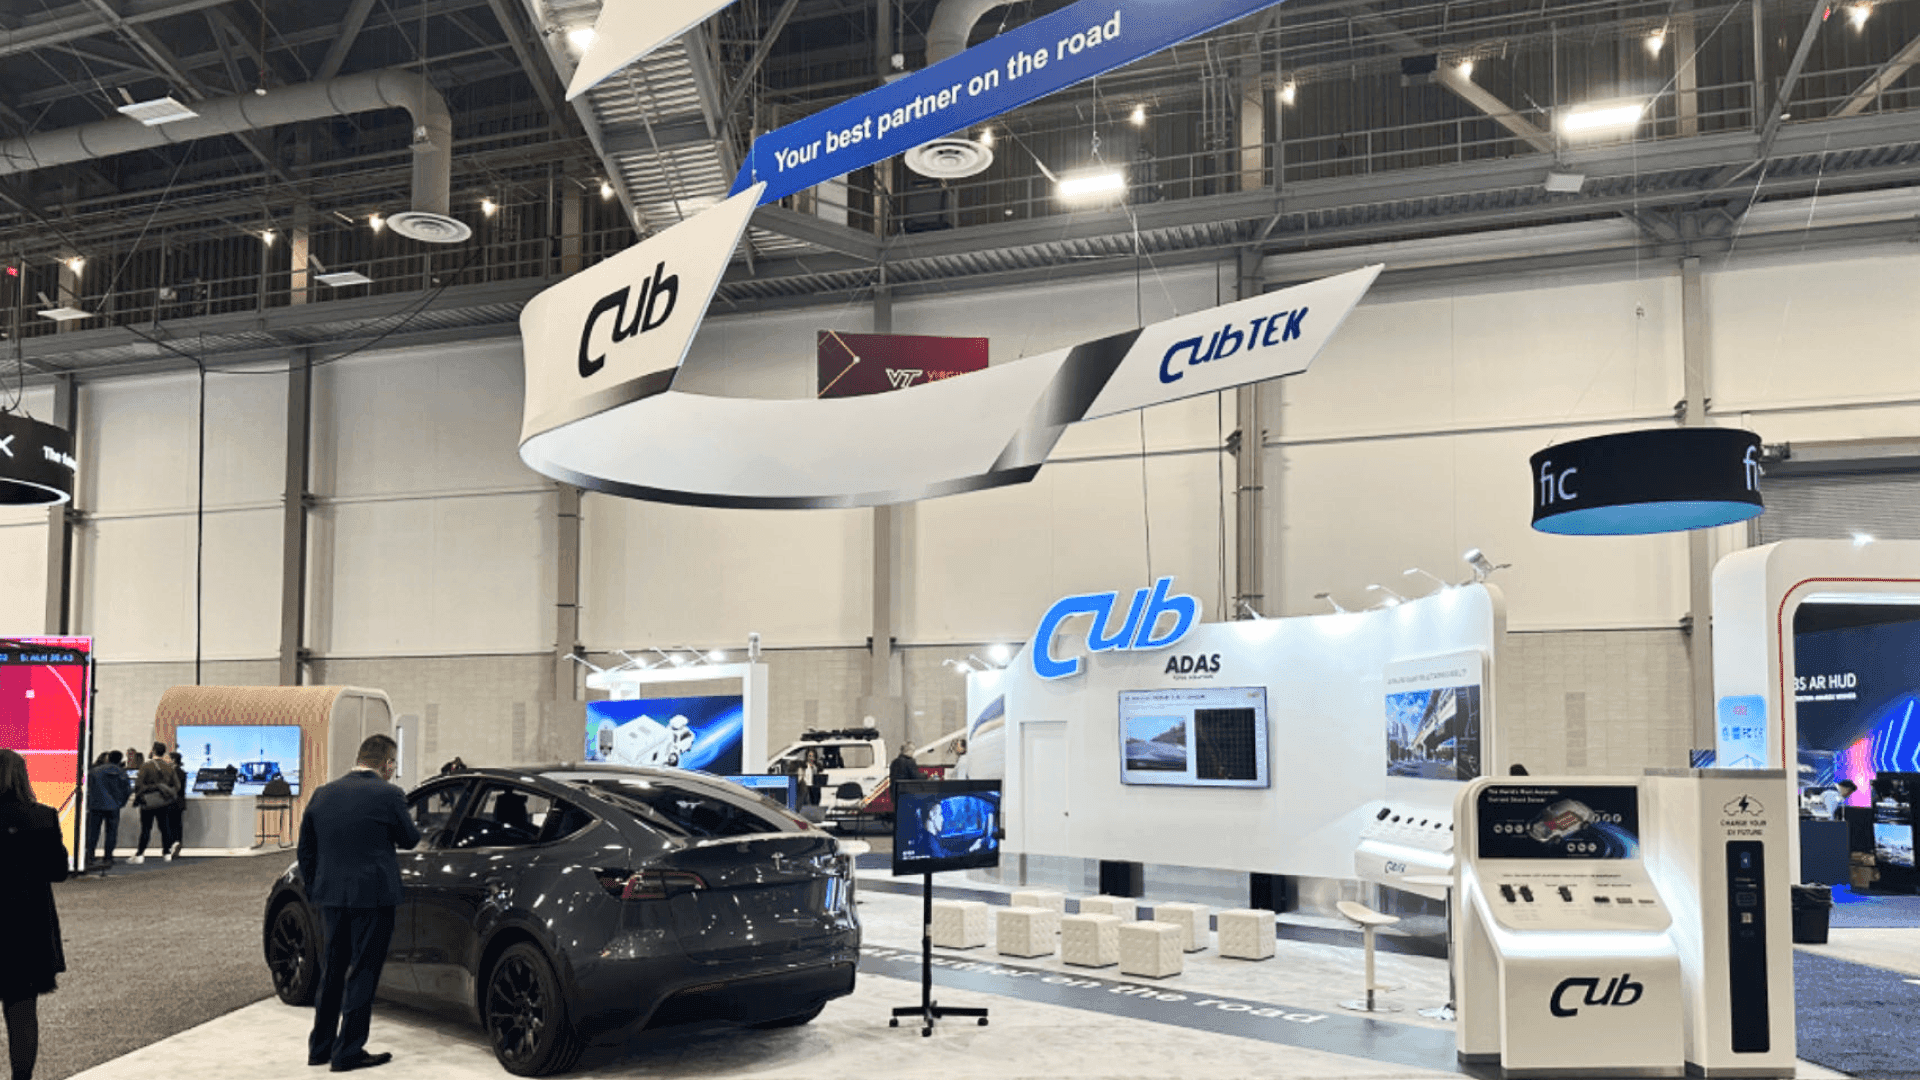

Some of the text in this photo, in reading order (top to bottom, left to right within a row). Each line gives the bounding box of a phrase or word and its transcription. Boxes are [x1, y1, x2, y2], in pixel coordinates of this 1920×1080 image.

[774, 9, 1121, 173] Your best partner on the road
[885, 368, 923, 389] VT
[1540, 461, 1577, 506] fic
[1164, 654, 1221, 674] ADAS
[1809, 674, 1827, 690] AR
[1828, 672, 1857, 689] HUD
[1041, 976, 1102, 989] on
[1108, 984, 1188, 1002] the
[1194, 998, 1329, 1024] road
